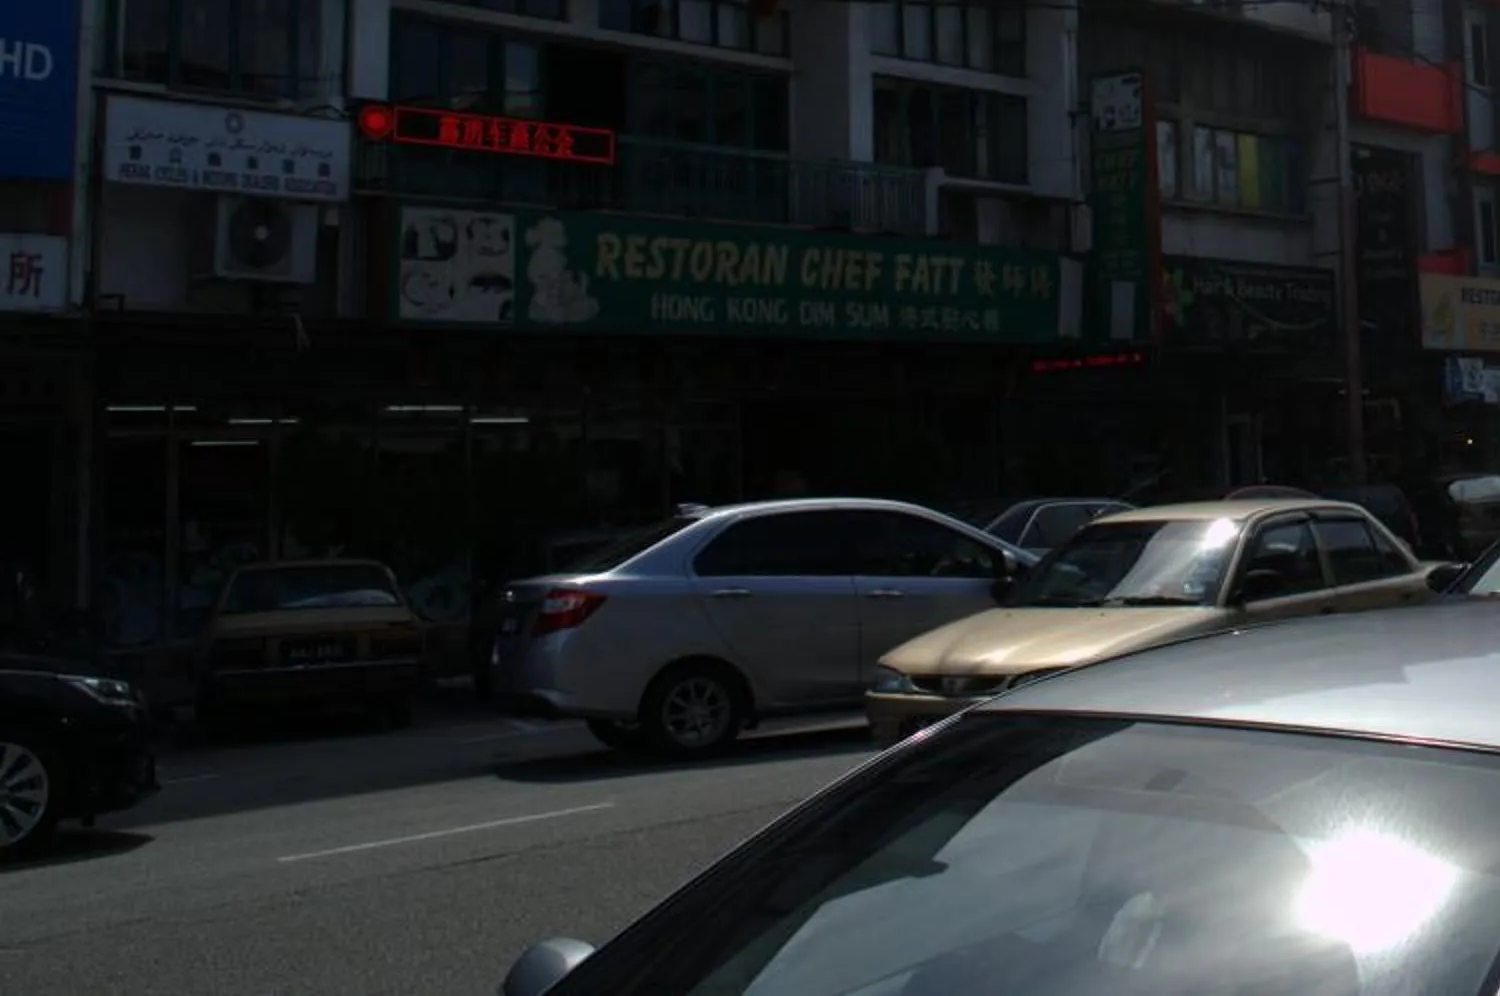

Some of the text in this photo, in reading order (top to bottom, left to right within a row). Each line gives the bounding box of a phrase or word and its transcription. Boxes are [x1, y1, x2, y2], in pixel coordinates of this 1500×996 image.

[597, 231, 966, 296] RESTORAN CHEF FATT
[651, 291, 890, 329] HONG KONG DIM SUM
